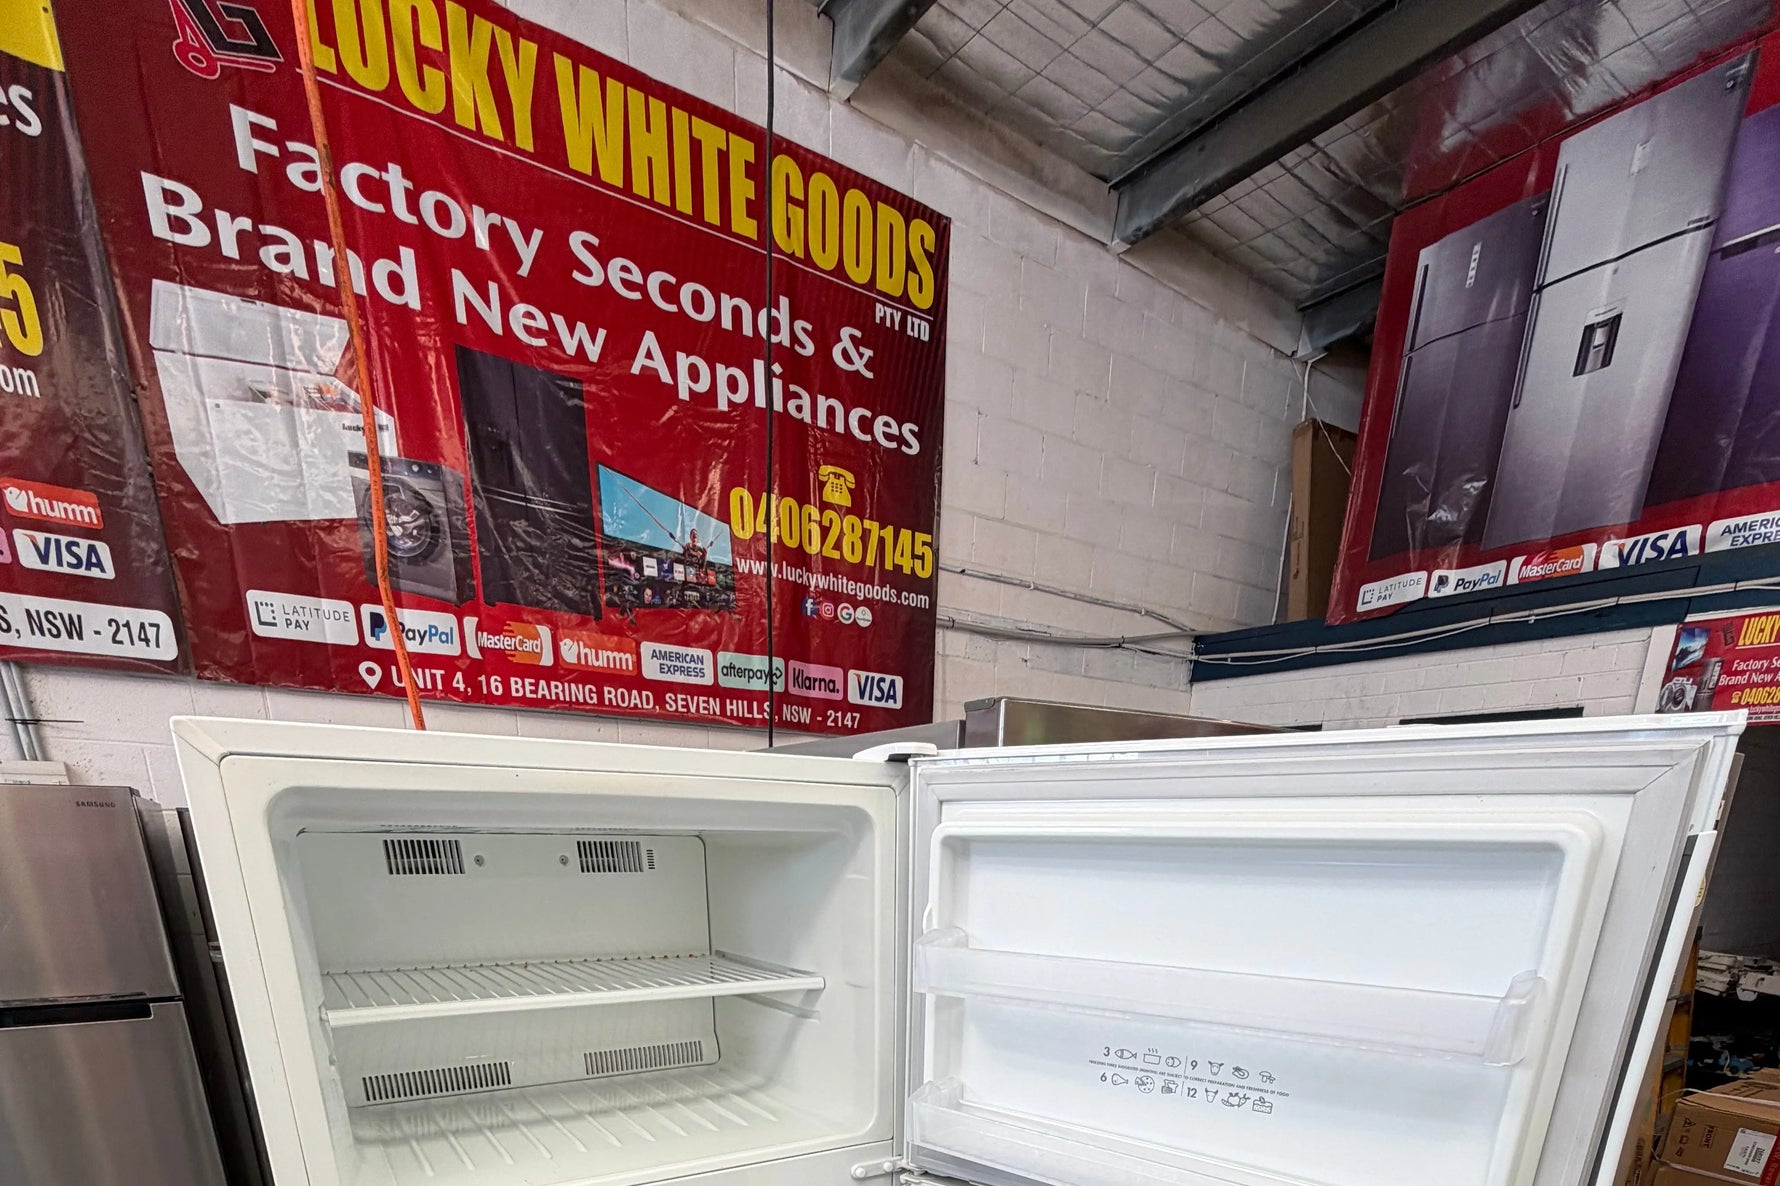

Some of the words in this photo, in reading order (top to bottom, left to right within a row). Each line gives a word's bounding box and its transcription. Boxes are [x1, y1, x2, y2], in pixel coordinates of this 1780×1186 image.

[306, 0, 538, 153] LUCKY
[553, 52, 758, 240] WHITE
[772, 154, 935, 310] GOODS
[229, 102, 544, 278] Factory
[569, 231, 815, 357] Seconds
[832, 326, 874, 379] &
[0, 242, 44, 356] 5
[140, 170, 421, 311] Brand
[451, 267, 607, 363] New
[630, 330, 920, 455] Appliances
[875, 302, 901, 331] PTY
[907, 315, 930, 342] LTD
[28, 490, 98, 525] humm
[729, 487, 933, 579] 0406287145
[22, 533, 107, 574] VISA
[1617, 531, 1689, 566] VISA
[1519, 554, 1583, 578] MasterCard
[1378, 577, 1423, 594] LATITUDE
[1454, 569, 1501, 592] PayPal
[1376, 593, 1393, 603] PAY
[282, 603, 351, 623] LATITUDE
[285, 618, 310, 631] PAY
[25, 608, 84, 641] NSW
[107, 618, 161, 648] 2147
[477, 630, 541, 653] MasterCard
[579, 640, 633, 670] humm
[651, 648, 704, 665] AMERICAN
[1731, 659, 1769, 672] Factory
[659, 663, 705, 678] EXPRESS
[721, 662, 769, 684] afterpay
[1718, 671, 1750, 686] Brand
[1750, 672, 1774, 684] New
[853, 672, 897, 704] VISA
[452, 672, 472, 695] 4,
[478, 674, 503, 696] 16
[510, 677, 597, 705] BEARING
[604, 687, 660, 713] ROAD,
[665, 694, 720, 716] SEVEN
[782, 704, 812, 724] NSW
[826, 709, 860, 729] 2147
[1103, 1046, 1111, 1057] 3
[1100, 1072, 1107, 1082] 6
[1190, 1060, 1198, 1071] 9
[1187, 1087, 1198, 1098] 12
